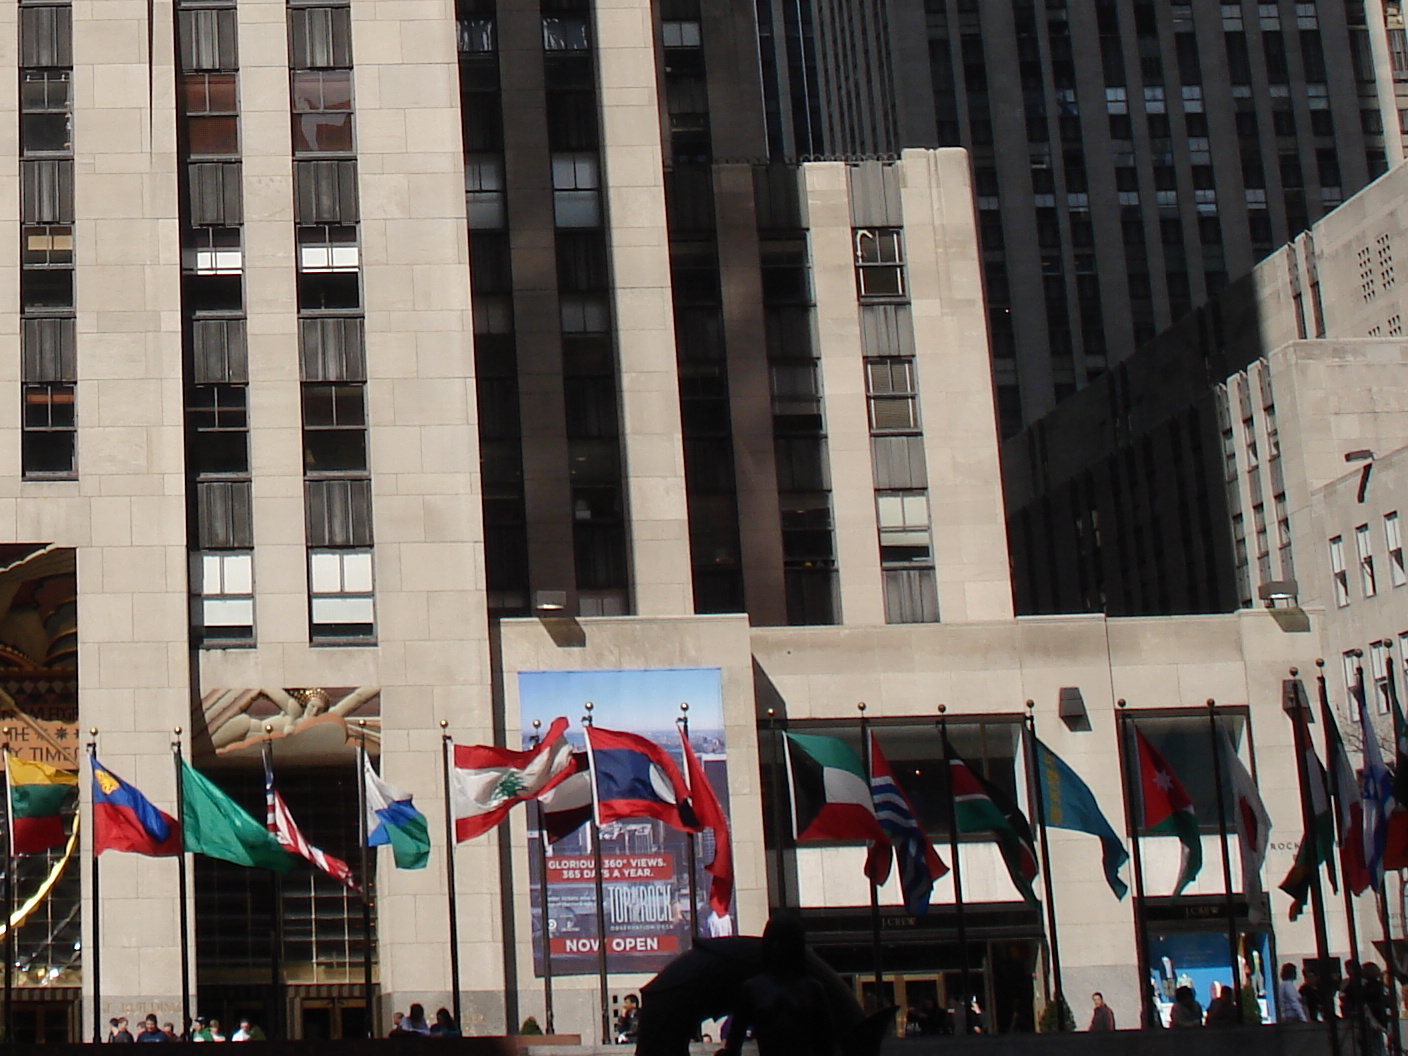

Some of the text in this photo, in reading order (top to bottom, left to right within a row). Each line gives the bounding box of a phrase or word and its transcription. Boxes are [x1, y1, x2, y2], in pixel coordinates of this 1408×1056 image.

[549, 860, 595, 869] GLORIOU
[629, 858, 667, 867] VIEWS.
[562, 870, 581, 879] 365
[613, 869, 621, 877] A
[623, 868, 654, 877] YEAR.
[608, 886, 630, 923] TOP
[640, 884, 674, 922] ROCK
[612, 937, 658, 951] OPEN
